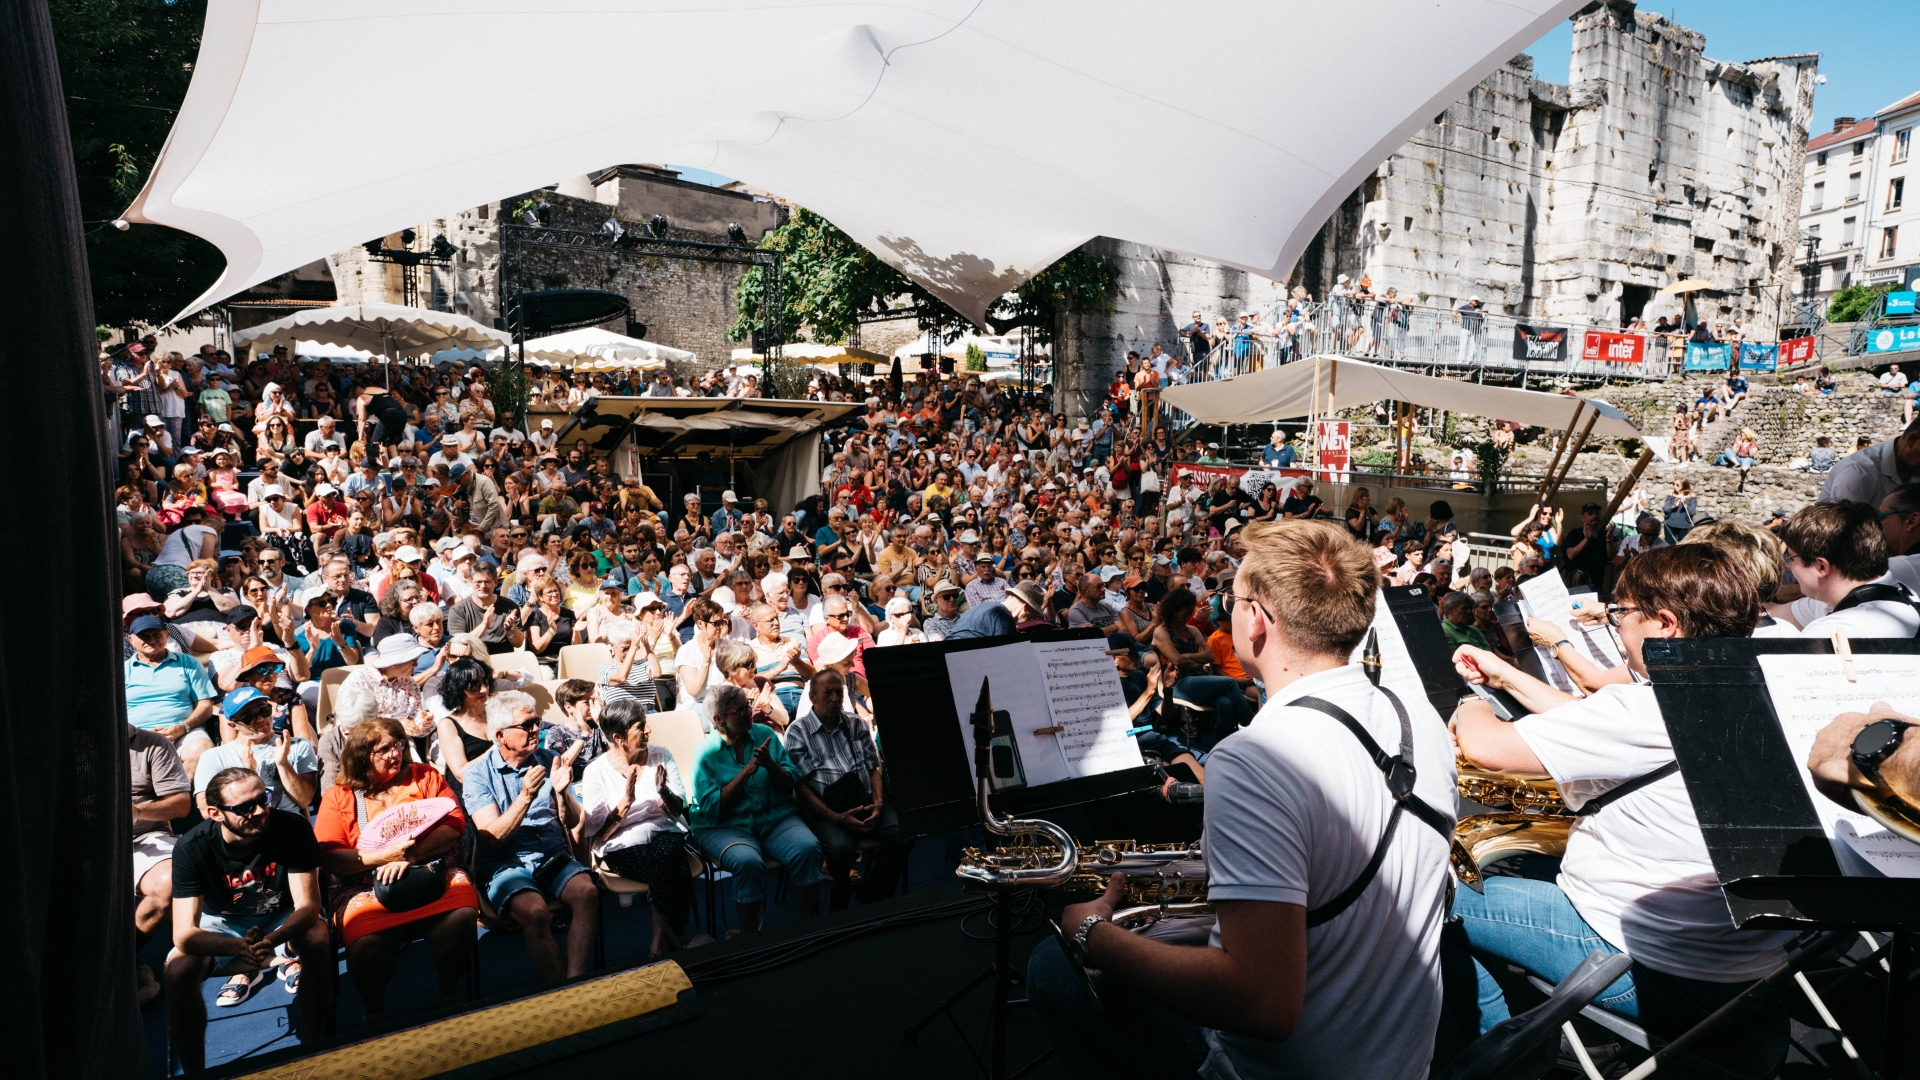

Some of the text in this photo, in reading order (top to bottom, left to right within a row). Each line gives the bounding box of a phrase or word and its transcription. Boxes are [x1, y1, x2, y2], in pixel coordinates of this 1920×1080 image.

[1900, 329, 1915, 340] La
[1609, 338, 1635, 359] inter
[1792, 344, 1809, 360] inter
